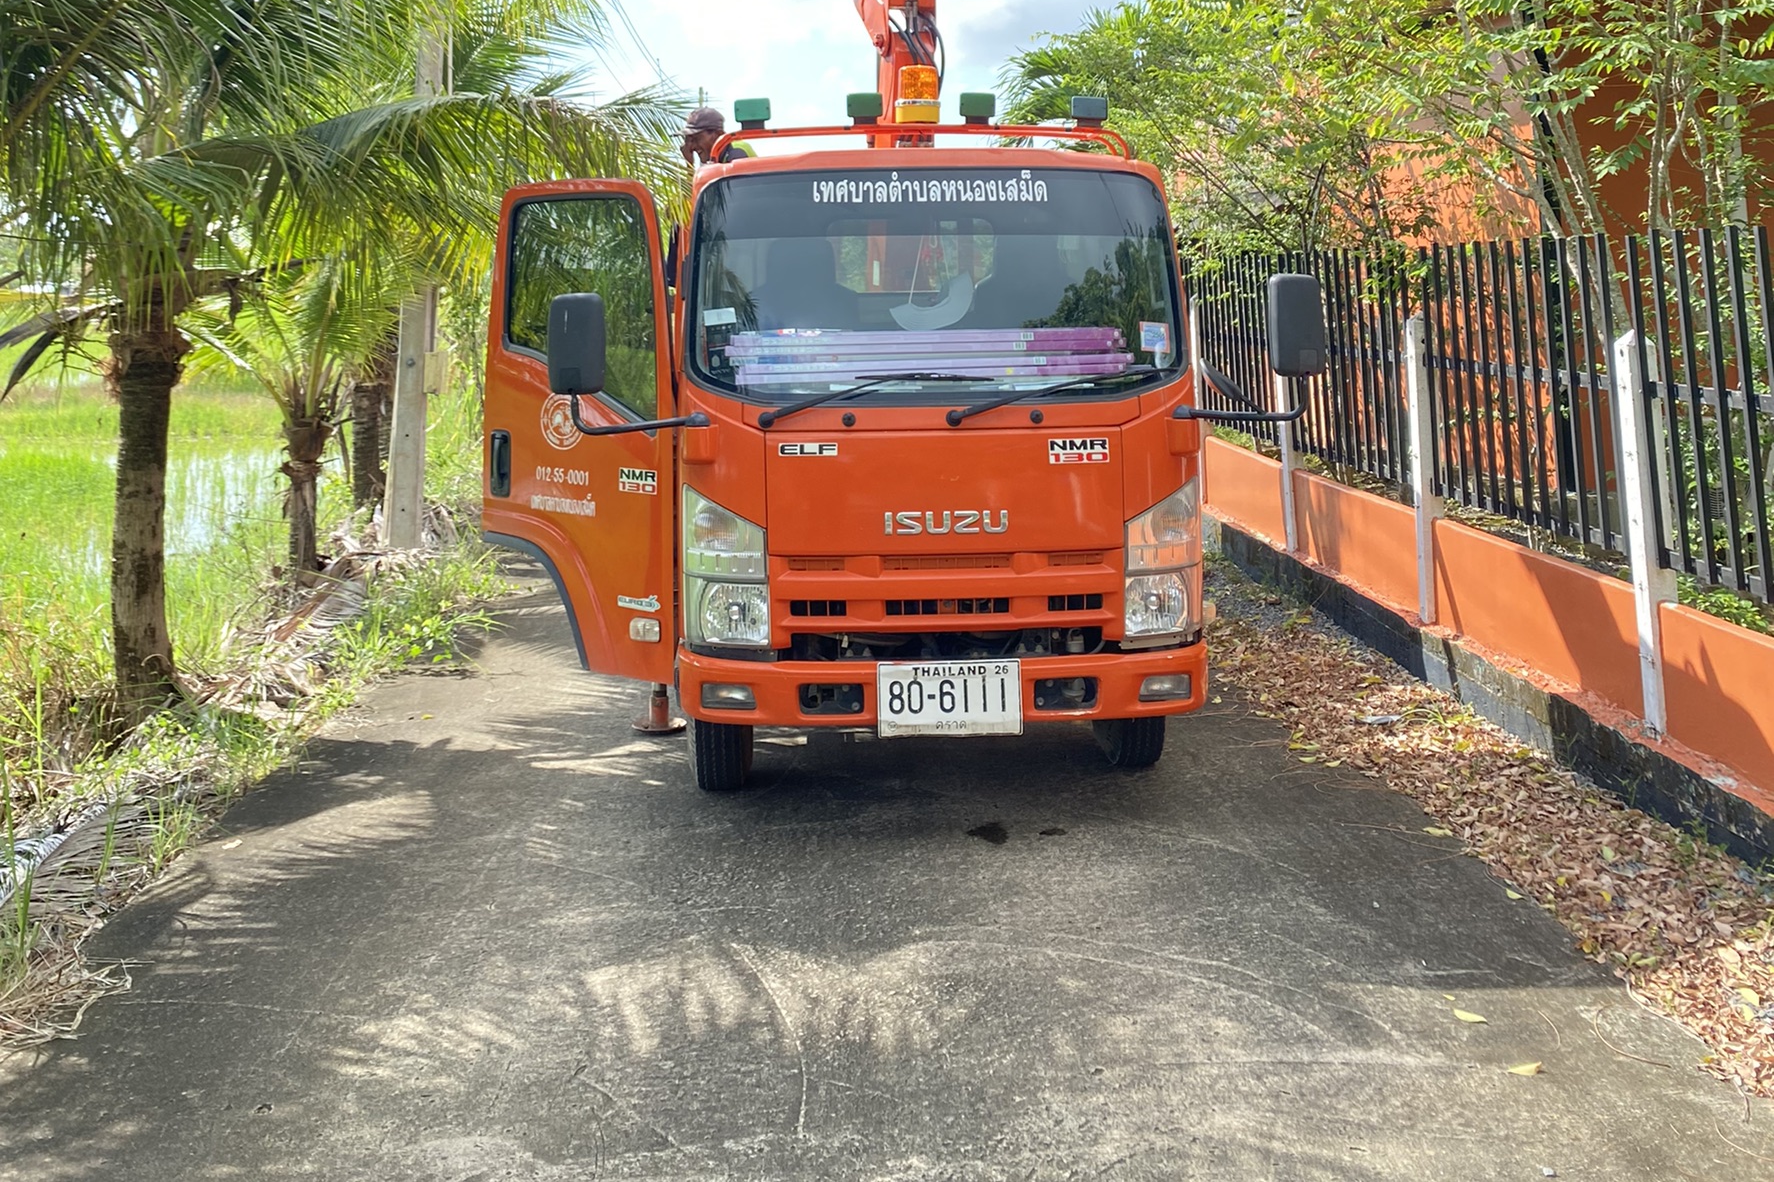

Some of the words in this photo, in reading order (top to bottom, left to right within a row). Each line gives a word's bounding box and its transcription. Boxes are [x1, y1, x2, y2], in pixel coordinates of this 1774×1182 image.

[812, 169, 1048, 203] เทศบาลตำบลหนองเสม็ด
[779, 444, 837, 455] ELF
[1049, 438, 1108, 451] NMR
[1049, 452, 1109, 463] 130
[535, 466, 589, 486] 012-55-0001
[619, 468, 656, 482] NMR
[619, 481, 656, 494] 130
[884, 509, 1009, 535] ISUZU
[912, 665, 987, 677] THAILAND
[995, 665, 1009, 675] 26
[888, 678, 1006, 715] 80-6111
